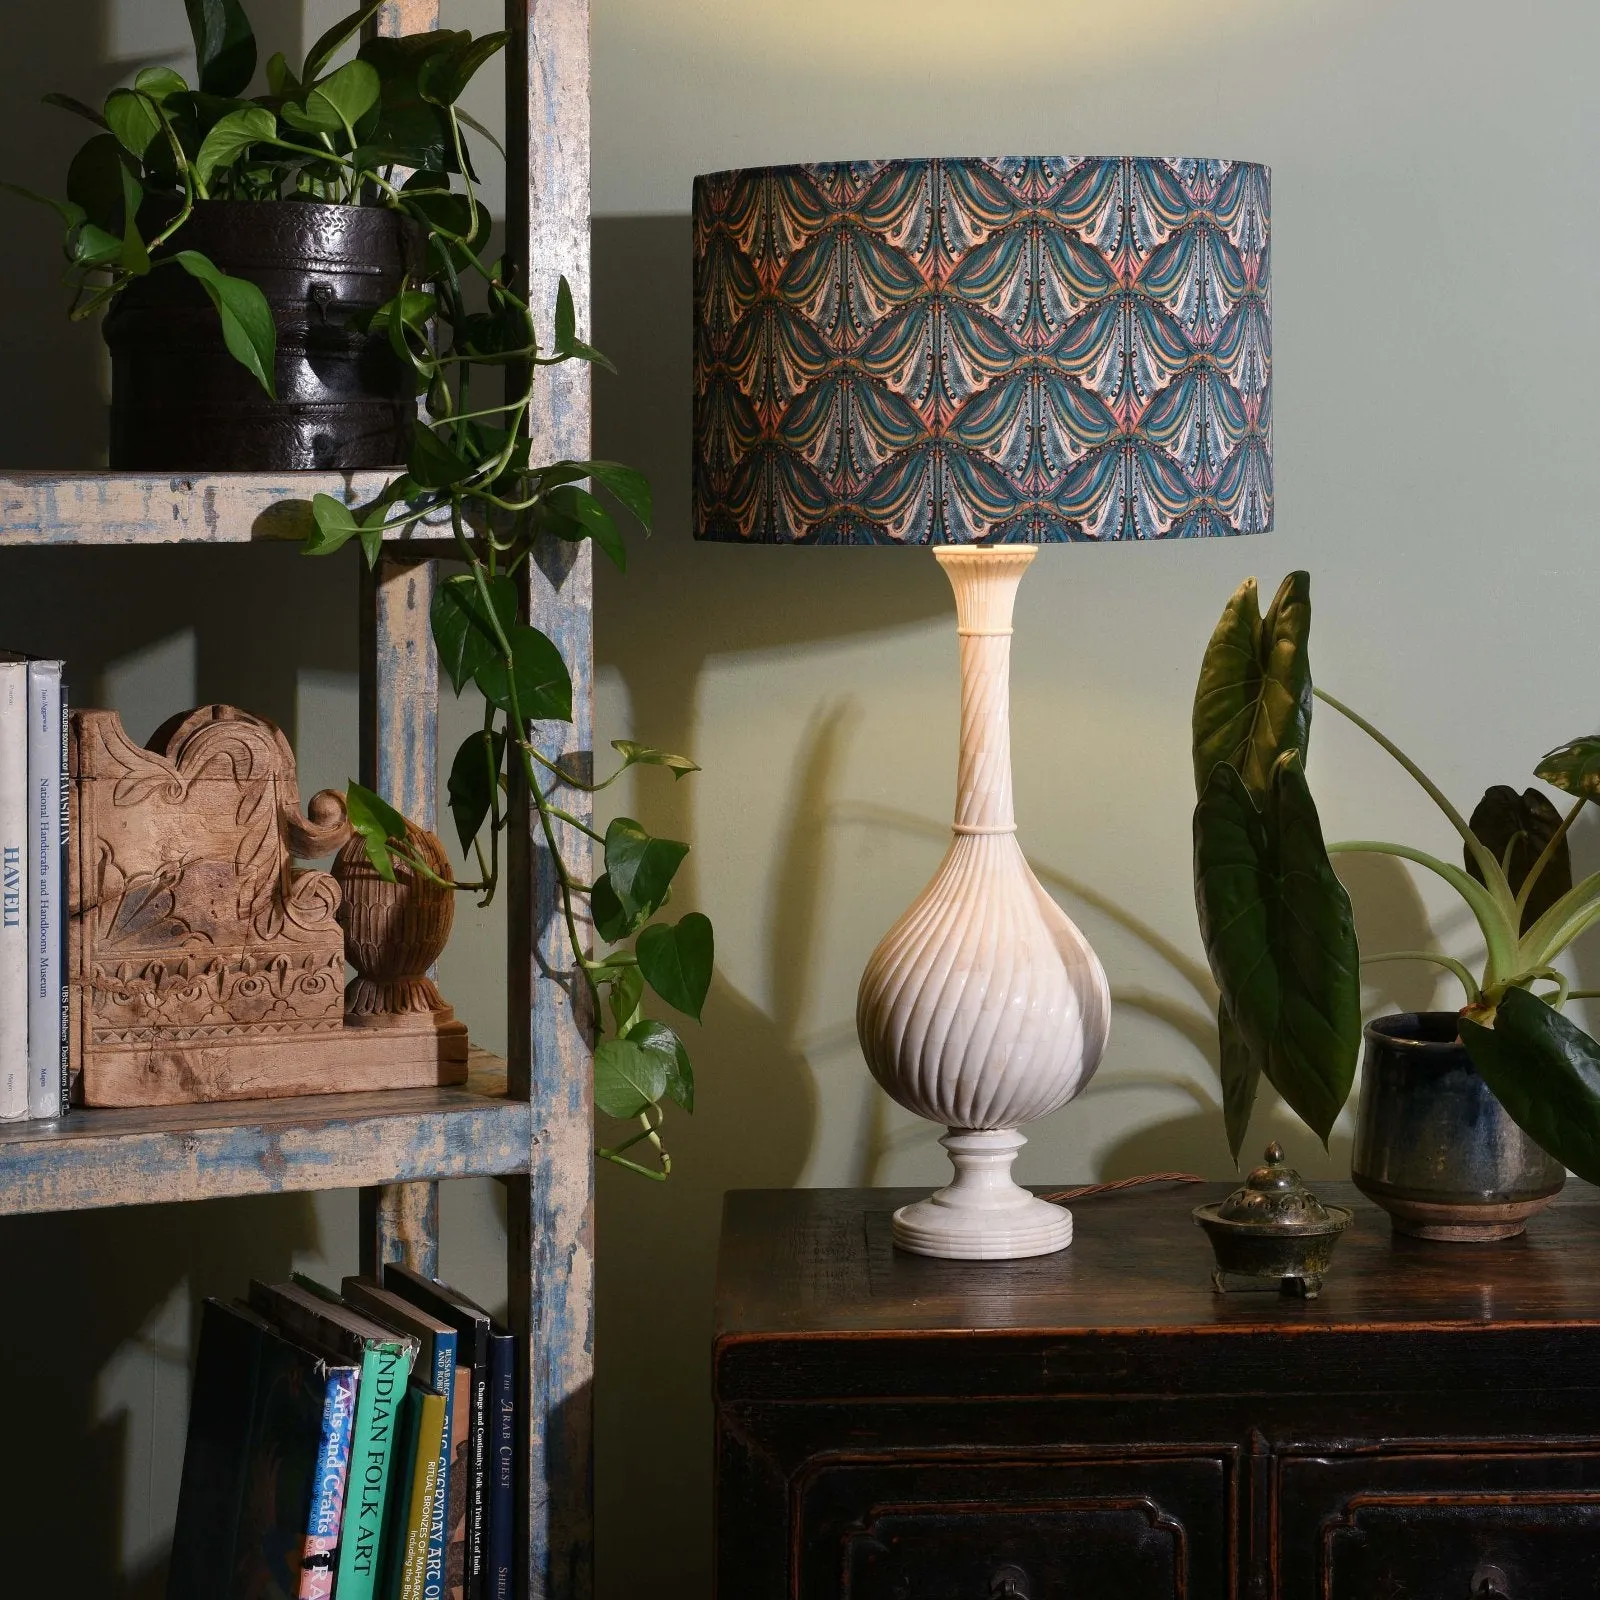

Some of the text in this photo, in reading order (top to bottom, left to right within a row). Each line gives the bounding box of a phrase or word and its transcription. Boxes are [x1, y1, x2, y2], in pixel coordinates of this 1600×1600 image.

[4, 846, 19, 928] HAVELI
[40, 778, 49, 998] National Handicrafts and Handlooms Museum
[61, 985, 69, 1003] UBS
[61, 1046, 69, 1088] Distributors
[437, 1350, 445, 1368] AND
[330, 1385, 351, 1428] Arts
[477, 1381, 486, 1410] Change
[500, 1399, 514, 1439] ARAB
[326, 1432, 341, 1468] and
[475, 1427, 484, 1470] Continuity:
[360, 1450, 385, 1519] FOLK
[424, 1461, 436, 1493] RITUAL
[475, 1472, 483, 1489] Folk
[499, 1446, 513, 1489] CHEST
[317, 1474, 340, 1534] Crafts
[419, 1495, 432, 1538] BRONZES
[474, 1508, 482, 1529] Tribal
[314, 1538, 330, 1558] of
[353, 1525, 375, 1577] ART
[404, 1530, 418, 1566] Including
[418, 1541, 426, 1554] OF
[474, 1530, 482, 1544] Art
[474, 1545, 481, 1555] of
[404, 1569, 413, 1583] the
[426, 1547, 442, 1580] ART
[473, 1555, 481, 1575] India
